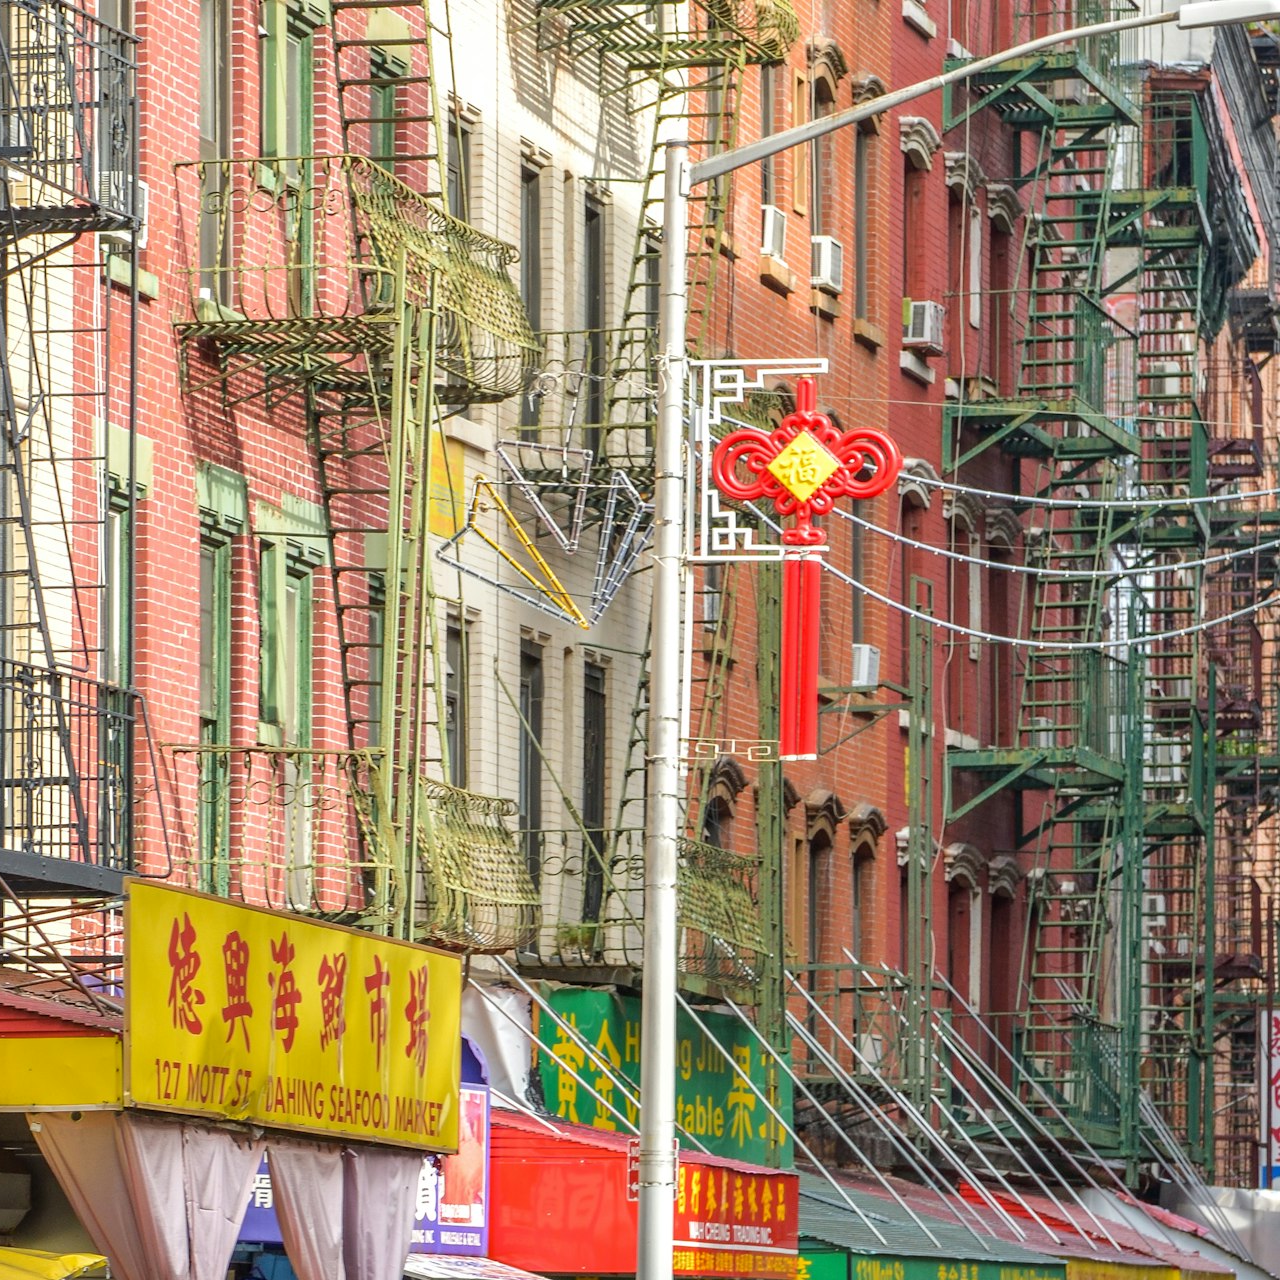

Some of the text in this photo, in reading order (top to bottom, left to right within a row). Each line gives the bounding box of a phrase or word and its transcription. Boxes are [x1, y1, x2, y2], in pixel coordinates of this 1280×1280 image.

[778, 447, 818, 486] 福
[155, 1059, 181, 1100] 127
[188, 1063, 229, 1106] MOTT
[329, 1085, 389, 1130] SEAFOOD
[394, 1096, 443, 1137] MARKET
